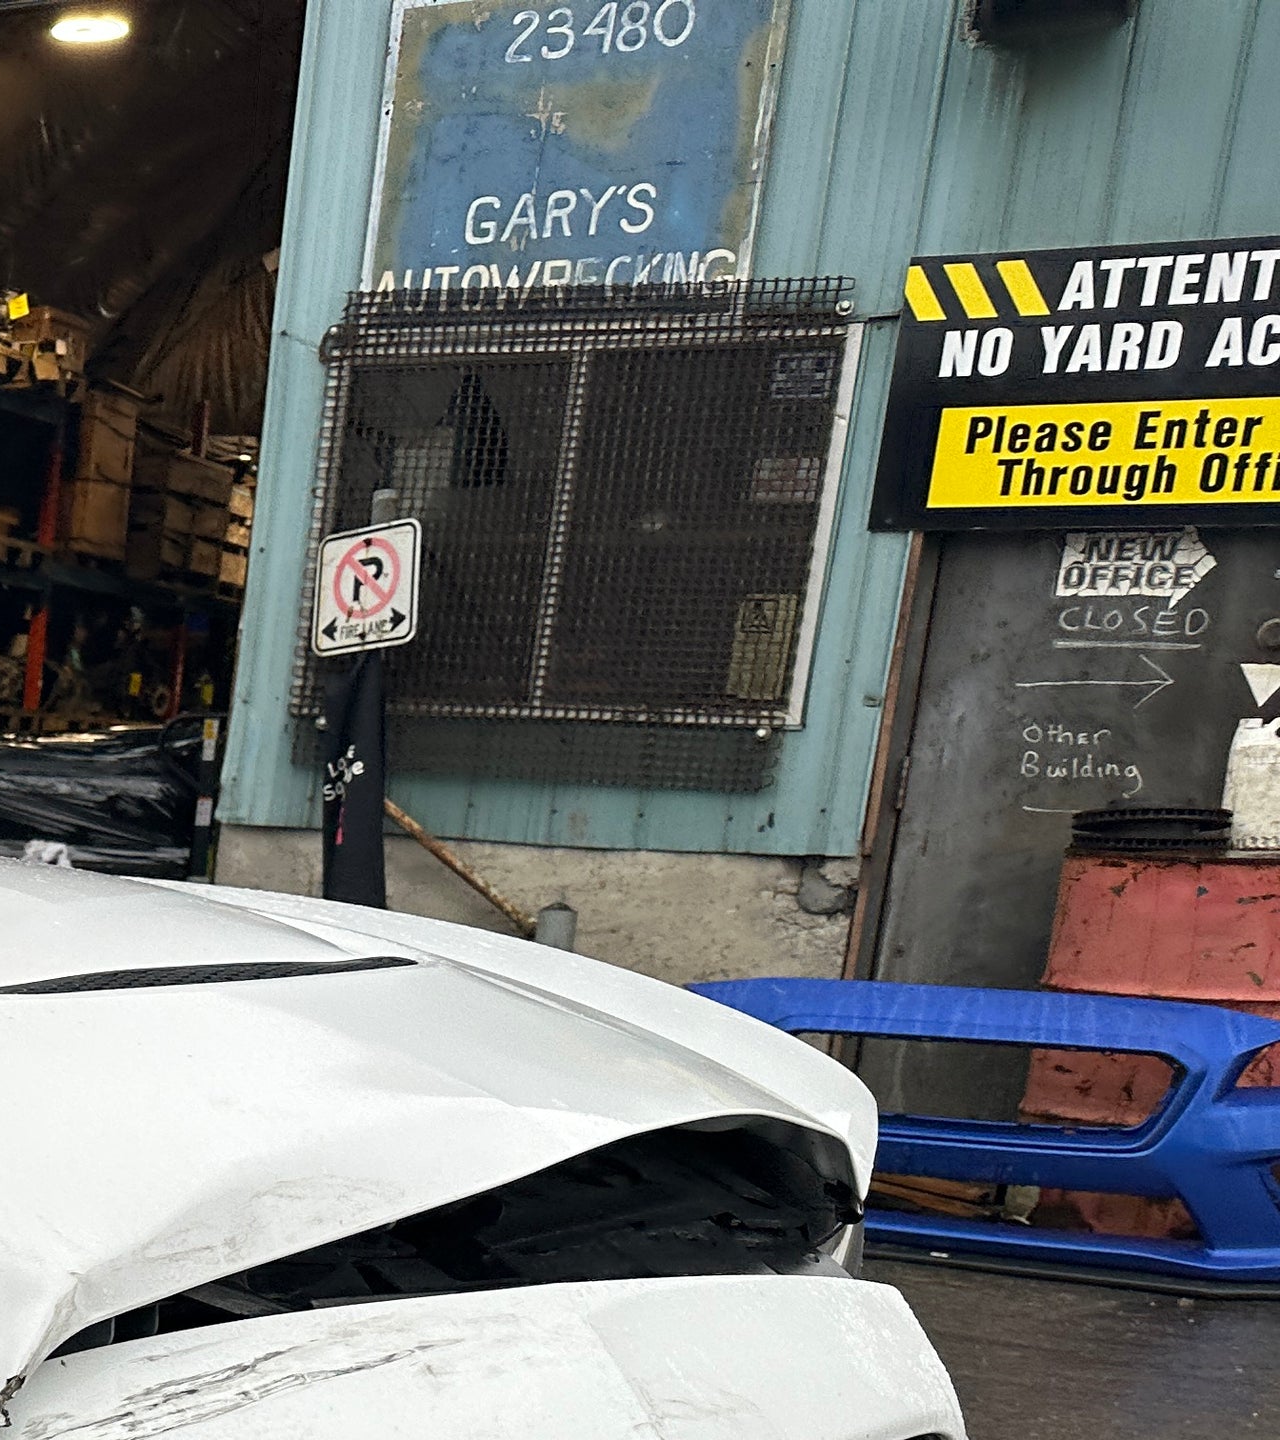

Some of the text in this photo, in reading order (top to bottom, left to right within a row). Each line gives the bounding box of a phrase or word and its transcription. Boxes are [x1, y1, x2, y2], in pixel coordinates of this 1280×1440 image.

[504, 0, 696, 63] 23480
[463, 182, 657, 245] GARY'S
[1056, 249, 1280, 312] ATTENT
[938, 314, 1280, 378] NO YARD AC
[965, 408, 1264, 454] Please Enter
[996, 455, 1177, 501] Through
[1083, 536, 1180, 562] NEW
[1062, 562, 1196, 590] OFFICE
[1058, 606, 1209, 635] CLOSED
[1020, 750, 1143, 799] Building
